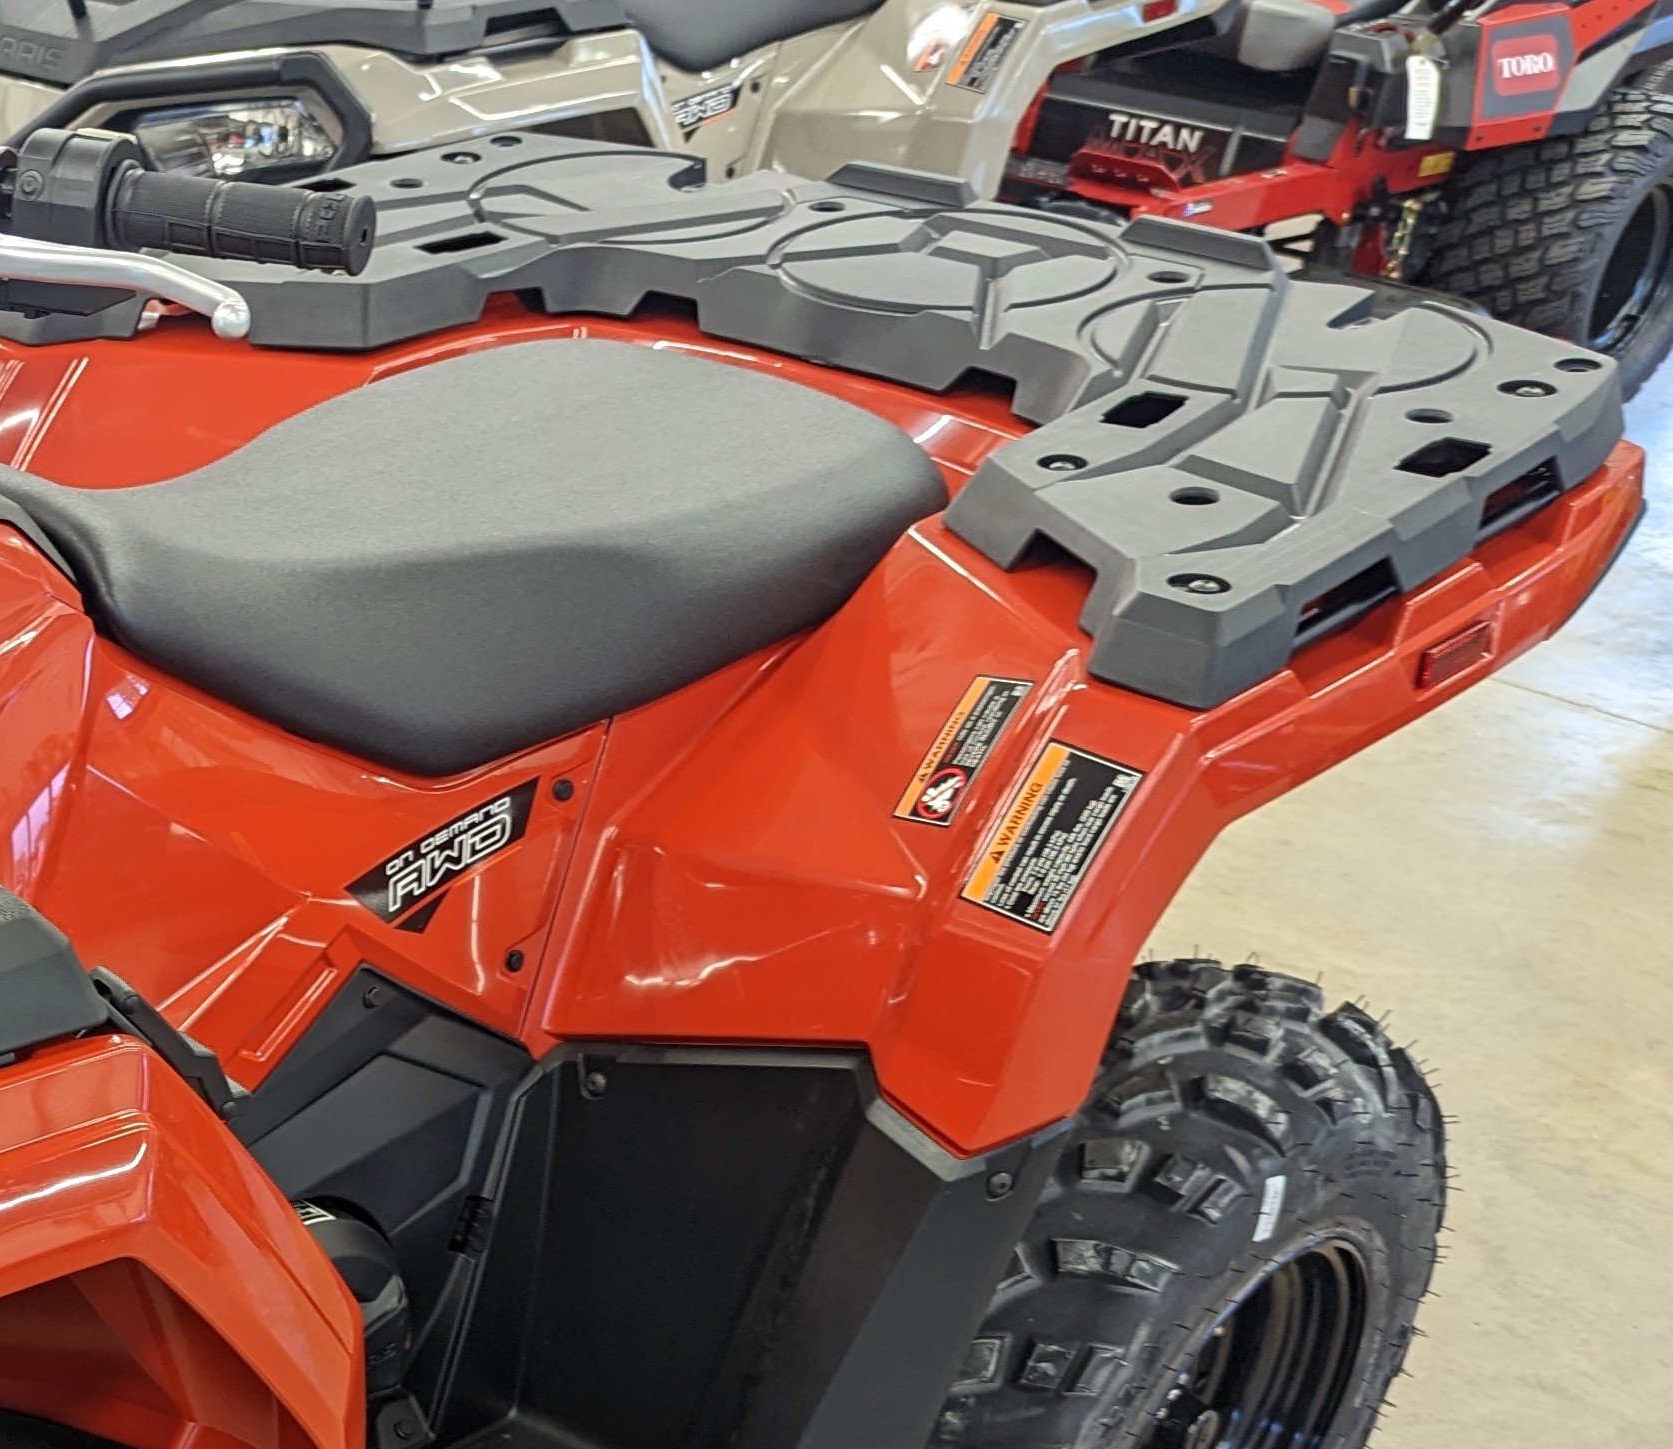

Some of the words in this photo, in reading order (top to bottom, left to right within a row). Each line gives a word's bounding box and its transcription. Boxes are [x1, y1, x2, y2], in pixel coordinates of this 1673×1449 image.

[1496, 52, 1555, 79] TORO
[1108, 112, 1205, 153] TITAN
[925, 711, 965, 775] WARNING
[385, 850, 415, 876] ON
[420, 796, 512, 854] DEMAND
[997, 782, 1044, 847] WARNING
[388, 814, 512, 912] AWD
